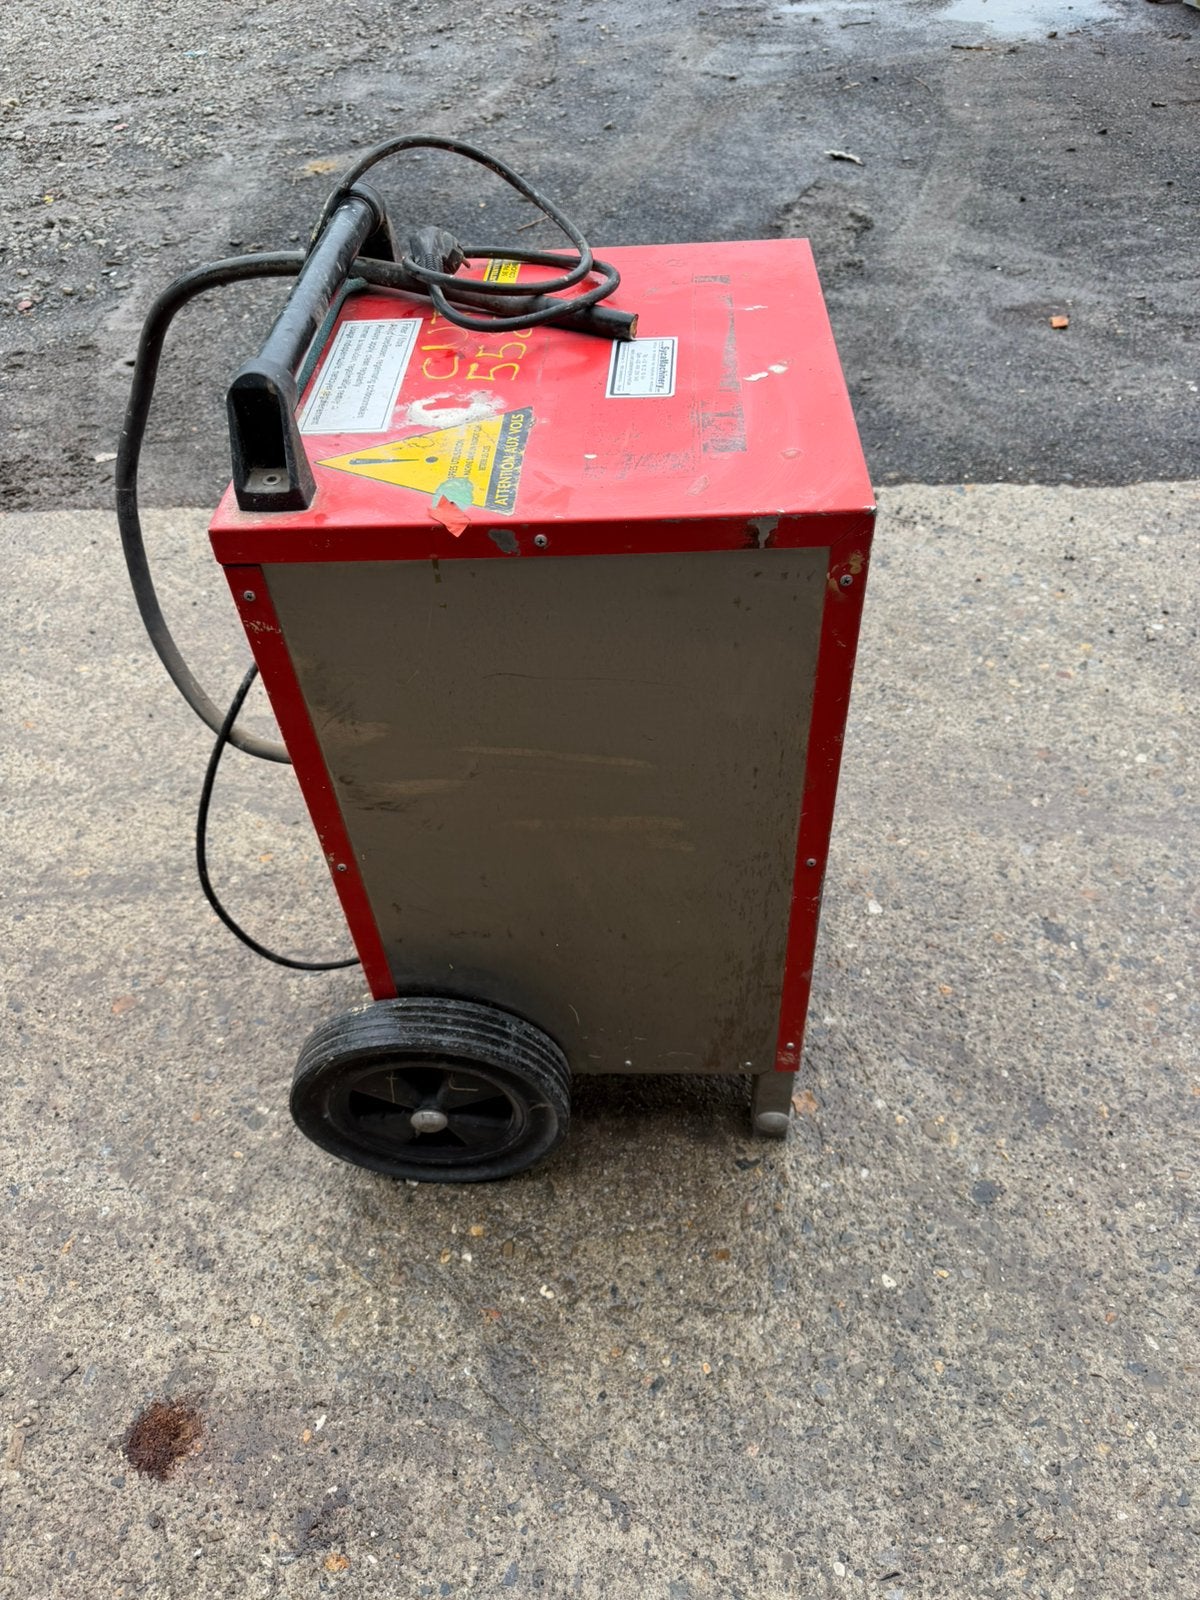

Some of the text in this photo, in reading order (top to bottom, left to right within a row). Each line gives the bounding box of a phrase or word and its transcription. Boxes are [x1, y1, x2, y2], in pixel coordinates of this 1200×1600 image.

[399, 322, 411, 334] Filter
[494, 413, 525, 506] ATTENTION AUX VOLS
